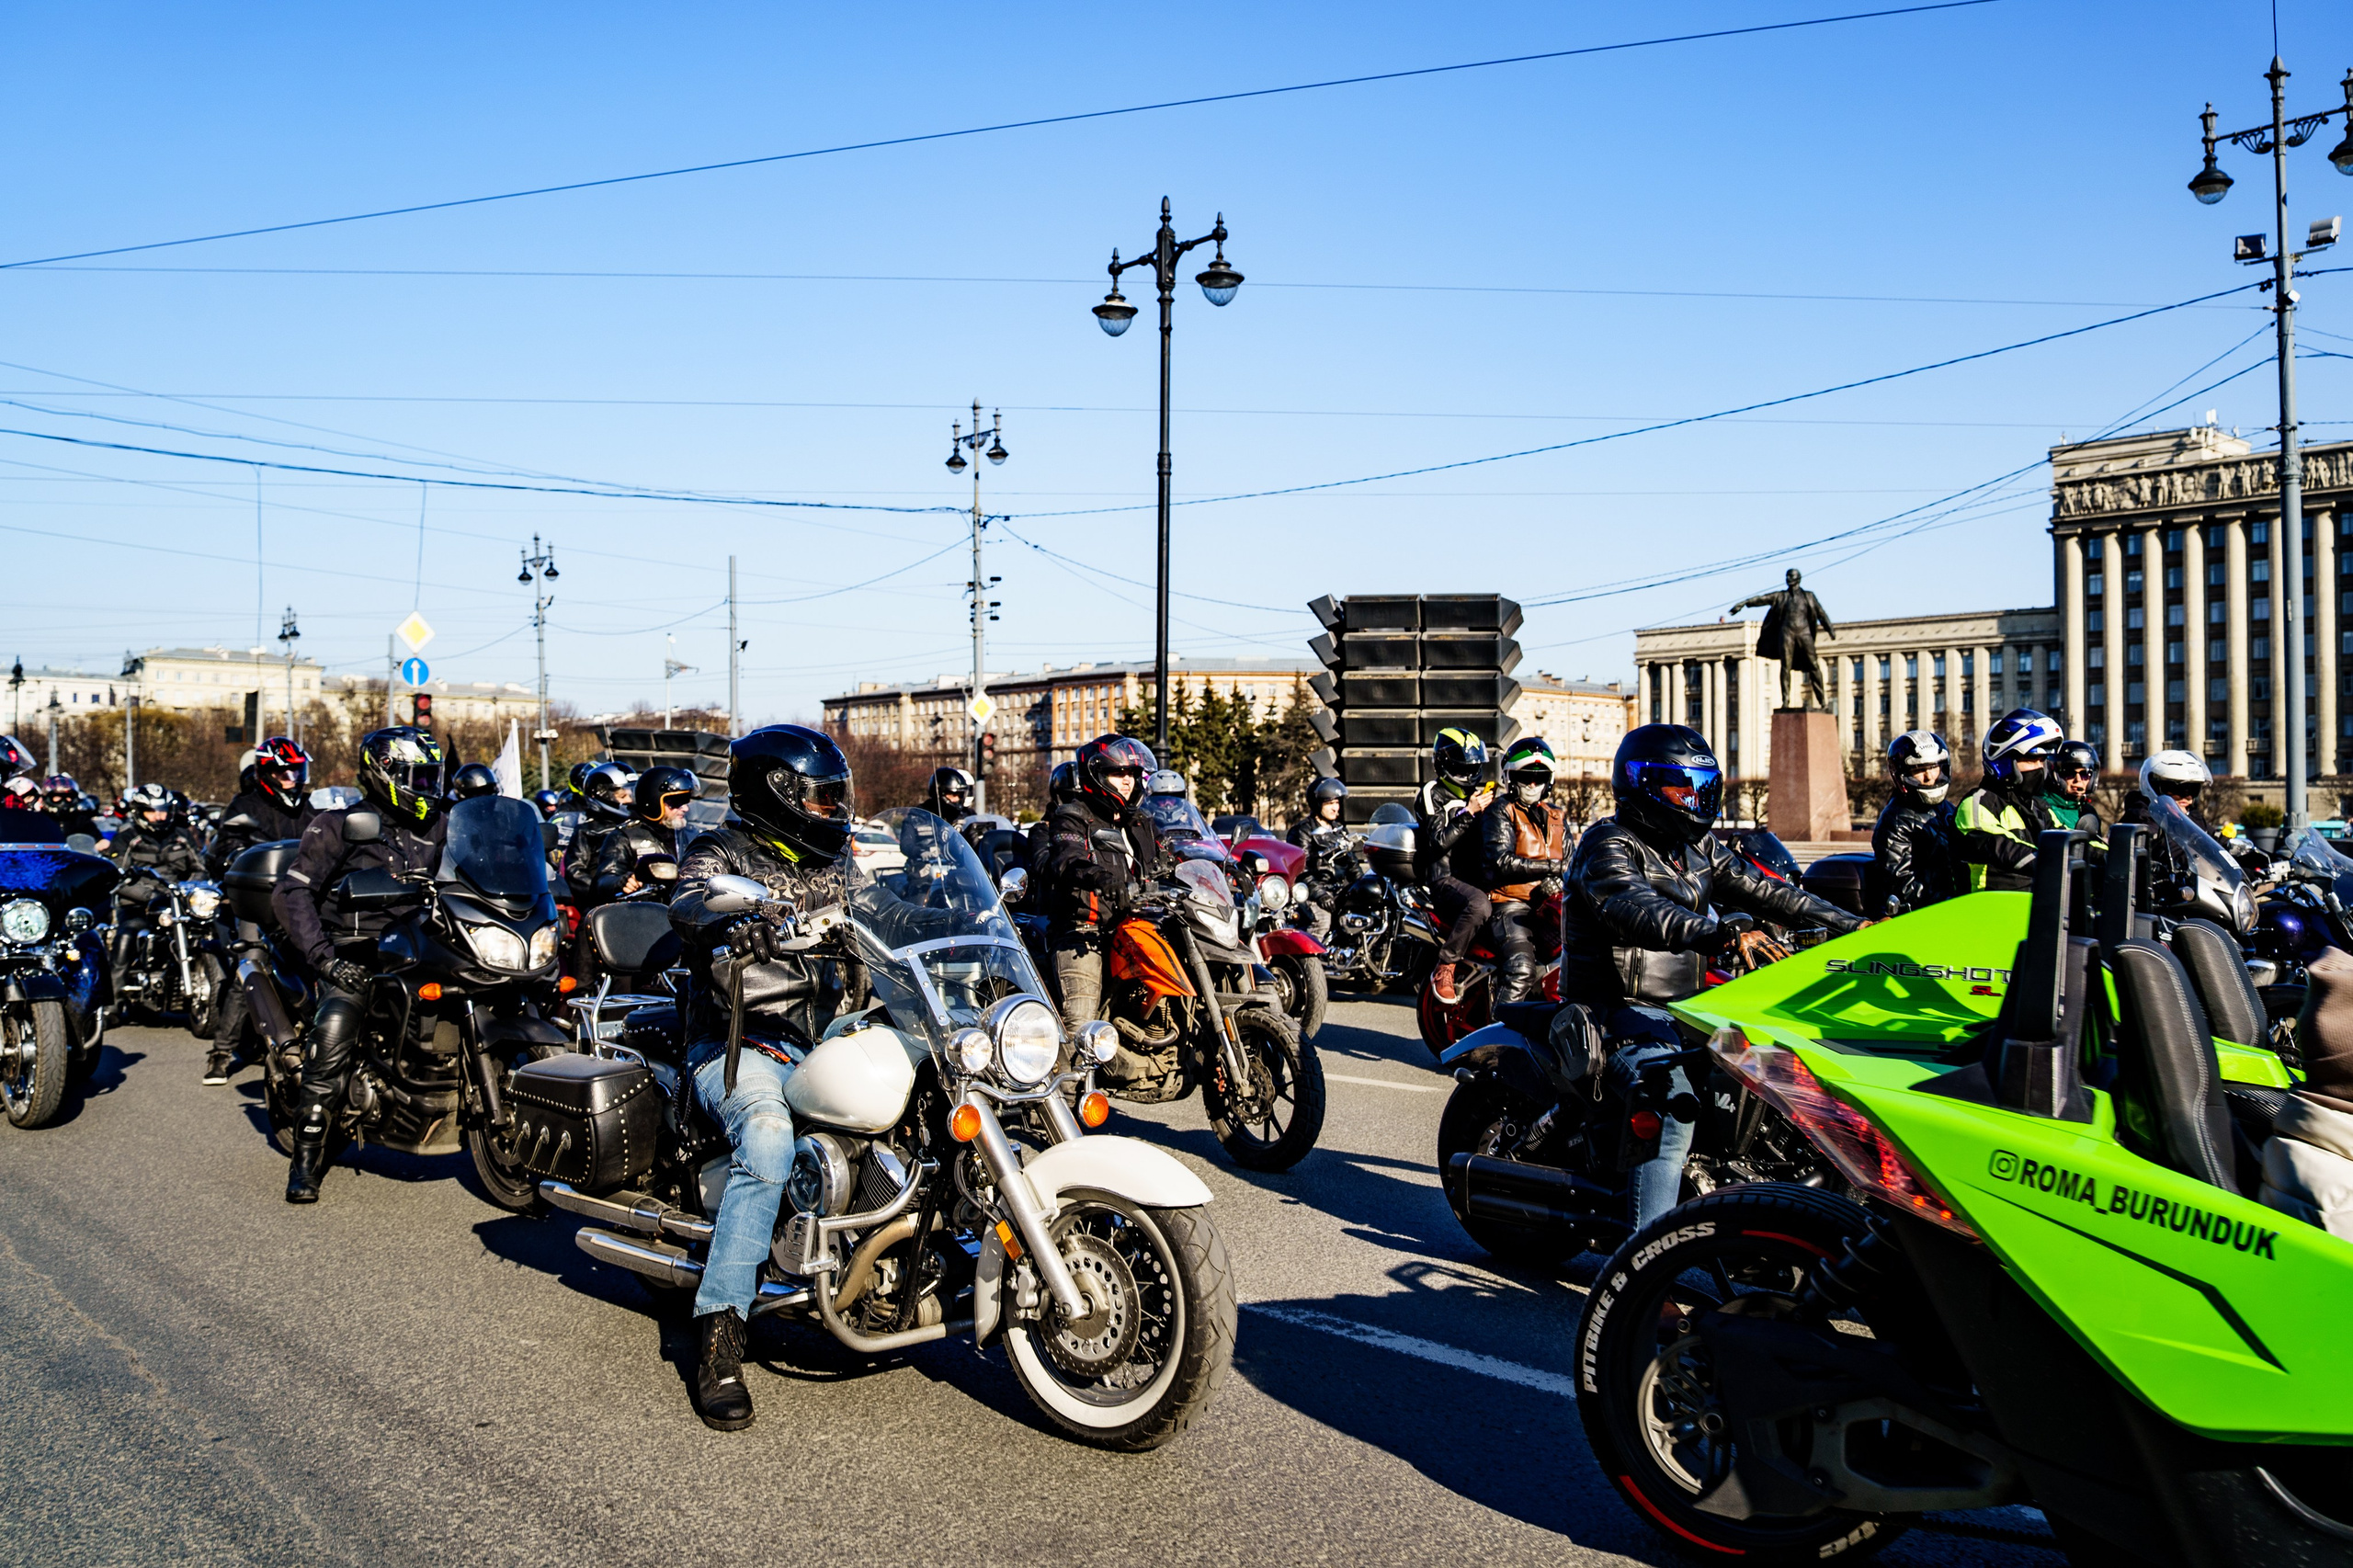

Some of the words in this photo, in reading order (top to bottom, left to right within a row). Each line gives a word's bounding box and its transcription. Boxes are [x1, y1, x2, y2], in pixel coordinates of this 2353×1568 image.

[1824, 959, 2012, 984] SLINGSHOT
[1969, 985, 2003, 997] SL
[2019, 1158, 2279, 1261] ROMA_BURUNDUK
[1583, 1290, 1615, 1393] PITBIKE
[1631, 1221, 1717, 1271] CROSS
